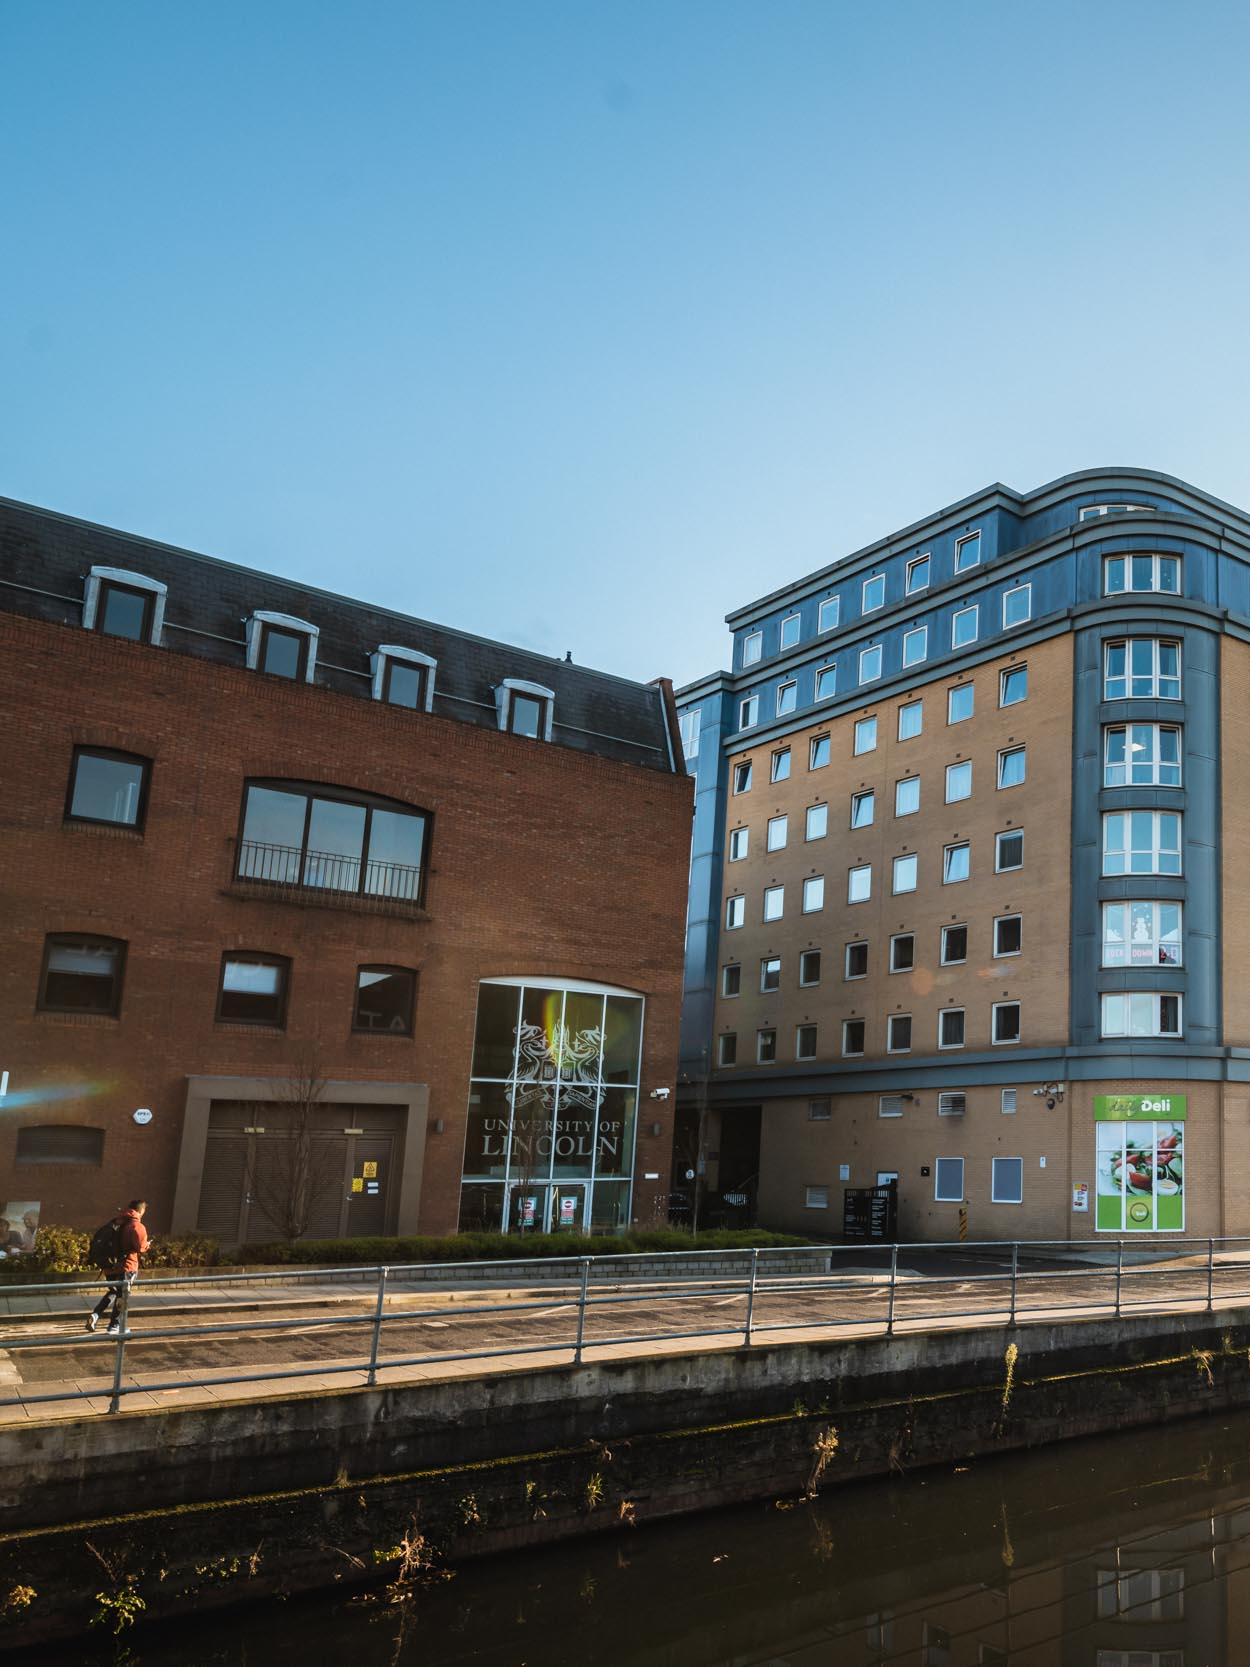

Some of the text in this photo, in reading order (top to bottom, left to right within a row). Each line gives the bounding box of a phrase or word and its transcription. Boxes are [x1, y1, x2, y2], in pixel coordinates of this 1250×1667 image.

[1141, 1099, 1171, 1112] Deli
[484, 1119, 621, 1132] UNIVERSITY OF
[481, 1135, 619, 1156] LINCOLN
